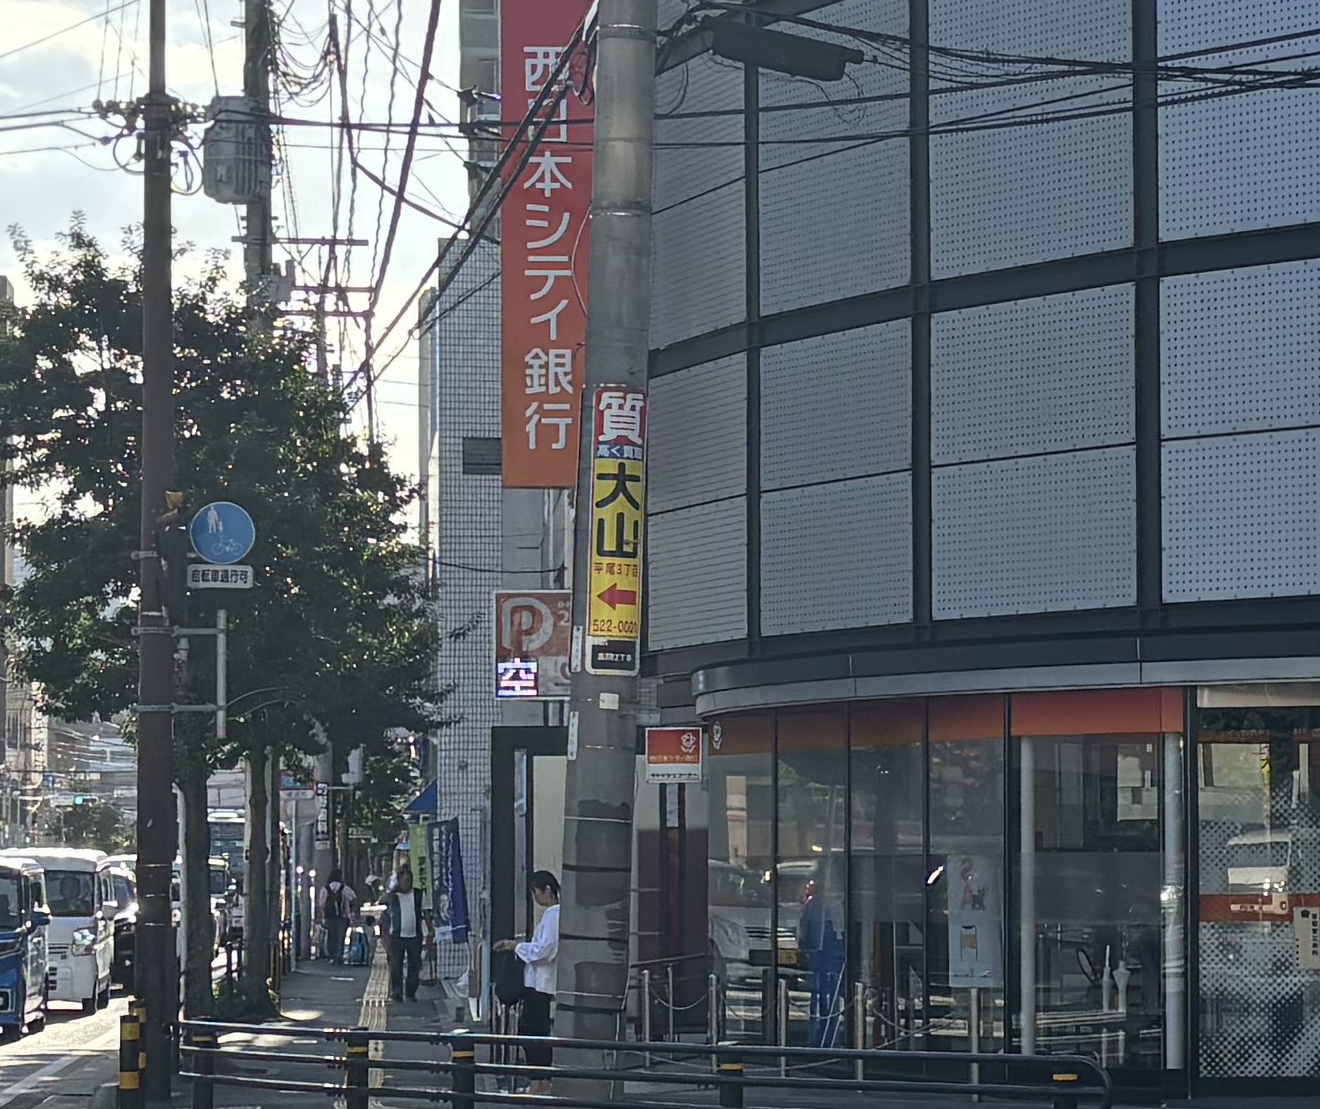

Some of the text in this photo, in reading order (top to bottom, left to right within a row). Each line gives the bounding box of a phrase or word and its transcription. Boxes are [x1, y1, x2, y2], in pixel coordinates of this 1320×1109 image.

[523, 46, 573, 450] 西日本シティ銀行
[599, 392, 645, 445] 質
[595, 462, 641, 559] 大山
[498, 658, 537, 696] 空
